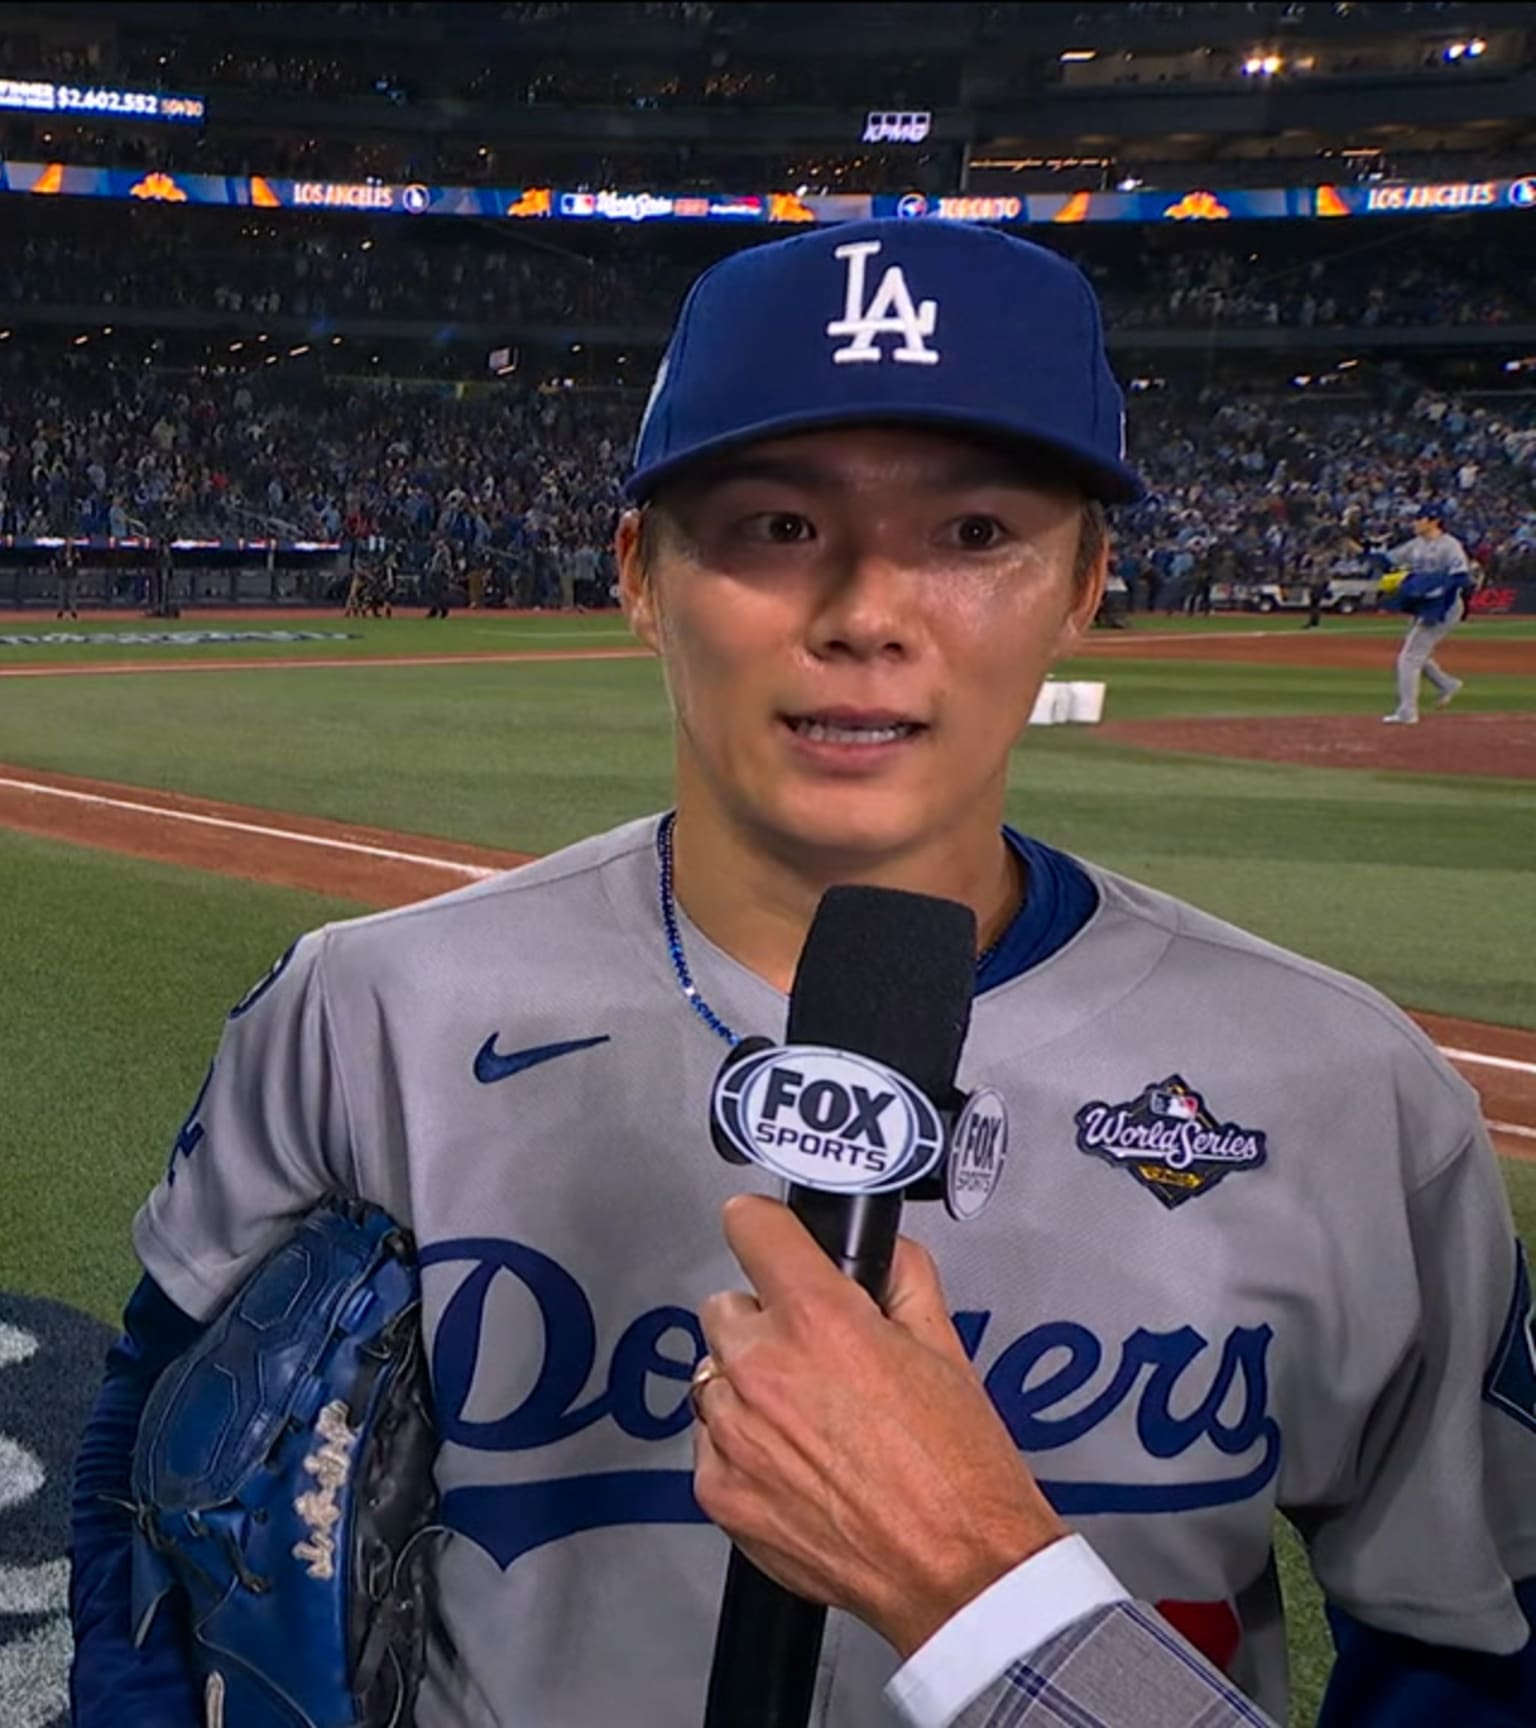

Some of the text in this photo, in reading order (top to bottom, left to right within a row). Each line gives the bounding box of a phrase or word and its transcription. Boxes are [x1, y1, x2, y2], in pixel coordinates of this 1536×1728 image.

[863, 118, 931, 143] KPMG
[293, 182, 393, 208] LOS ANGELES
[1367, 181, 1497, 210] LOS ANGELES
[827, 240, 940, 364] LA
[760, 1066, 898, 1150] FOX
[754, 1121, 888, 1173] SPORTS
[962, 1112, 1003, 1170] FOX
[1085, 1107, 1258, 1169] World Series
